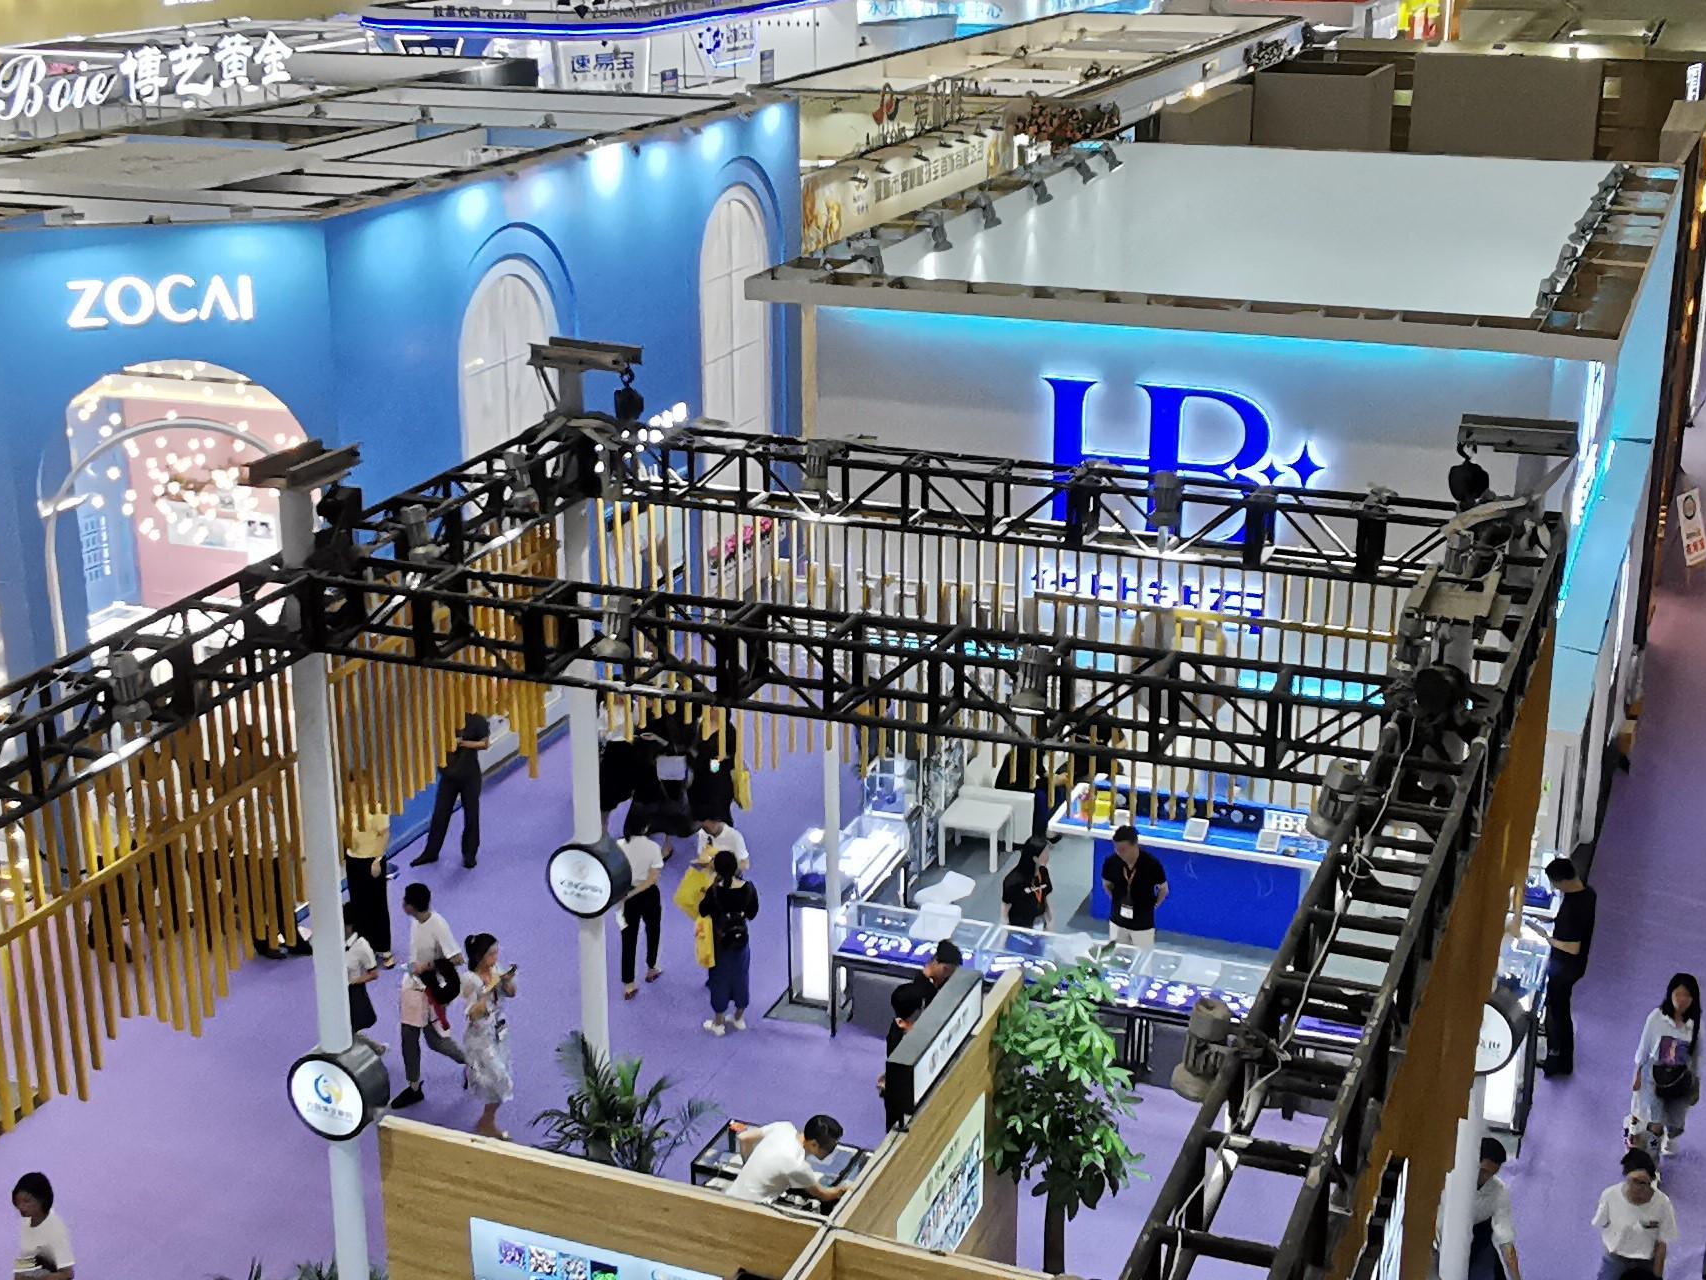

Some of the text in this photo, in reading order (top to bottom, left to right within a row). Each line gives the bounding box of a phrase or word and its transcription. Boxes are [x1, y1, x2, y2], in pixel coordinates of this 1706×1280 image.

[119, 31, 293, 104] 博艺黄金
[66, 273, 254, 330] ZOCAI
